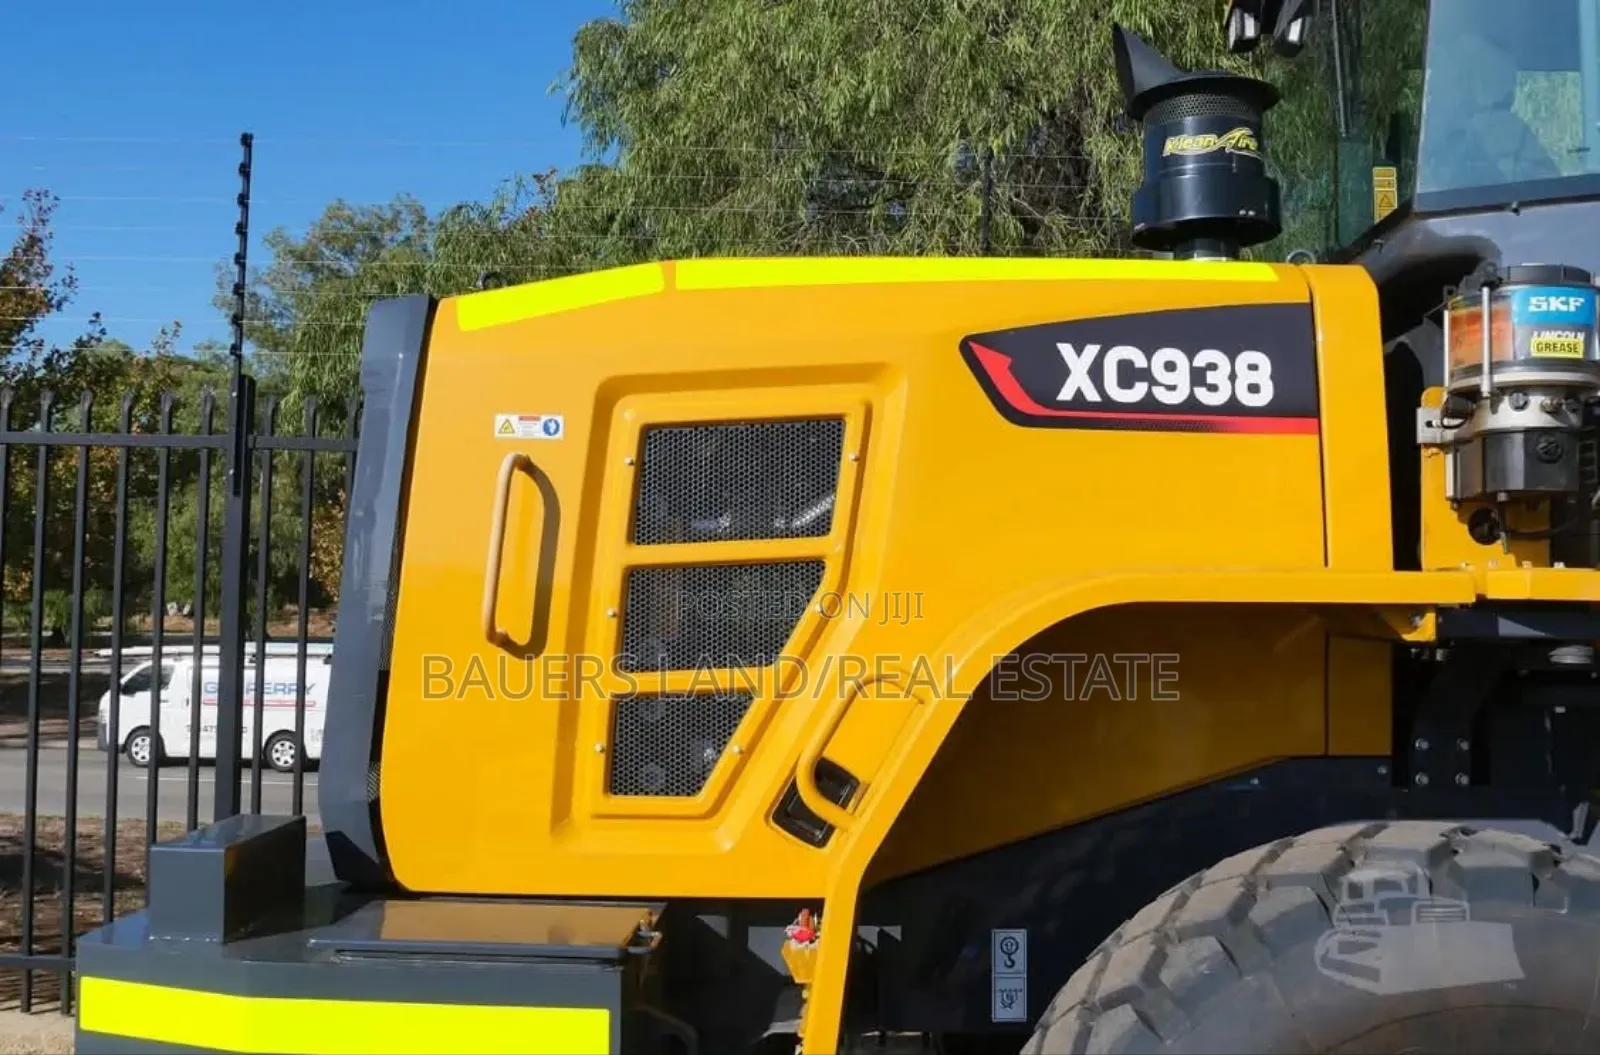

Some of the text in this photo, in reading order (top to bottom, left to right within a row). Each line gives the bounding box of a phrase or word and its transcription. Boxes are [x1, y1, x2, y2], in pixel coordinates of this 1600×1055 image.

[1528, 296, 1585, 312] SKF
[1532, 330, 1585, 340] LINCOLN
[1535, 342, 1580, 353] GREASE
[1056, 342, 1274, 407] XC938
